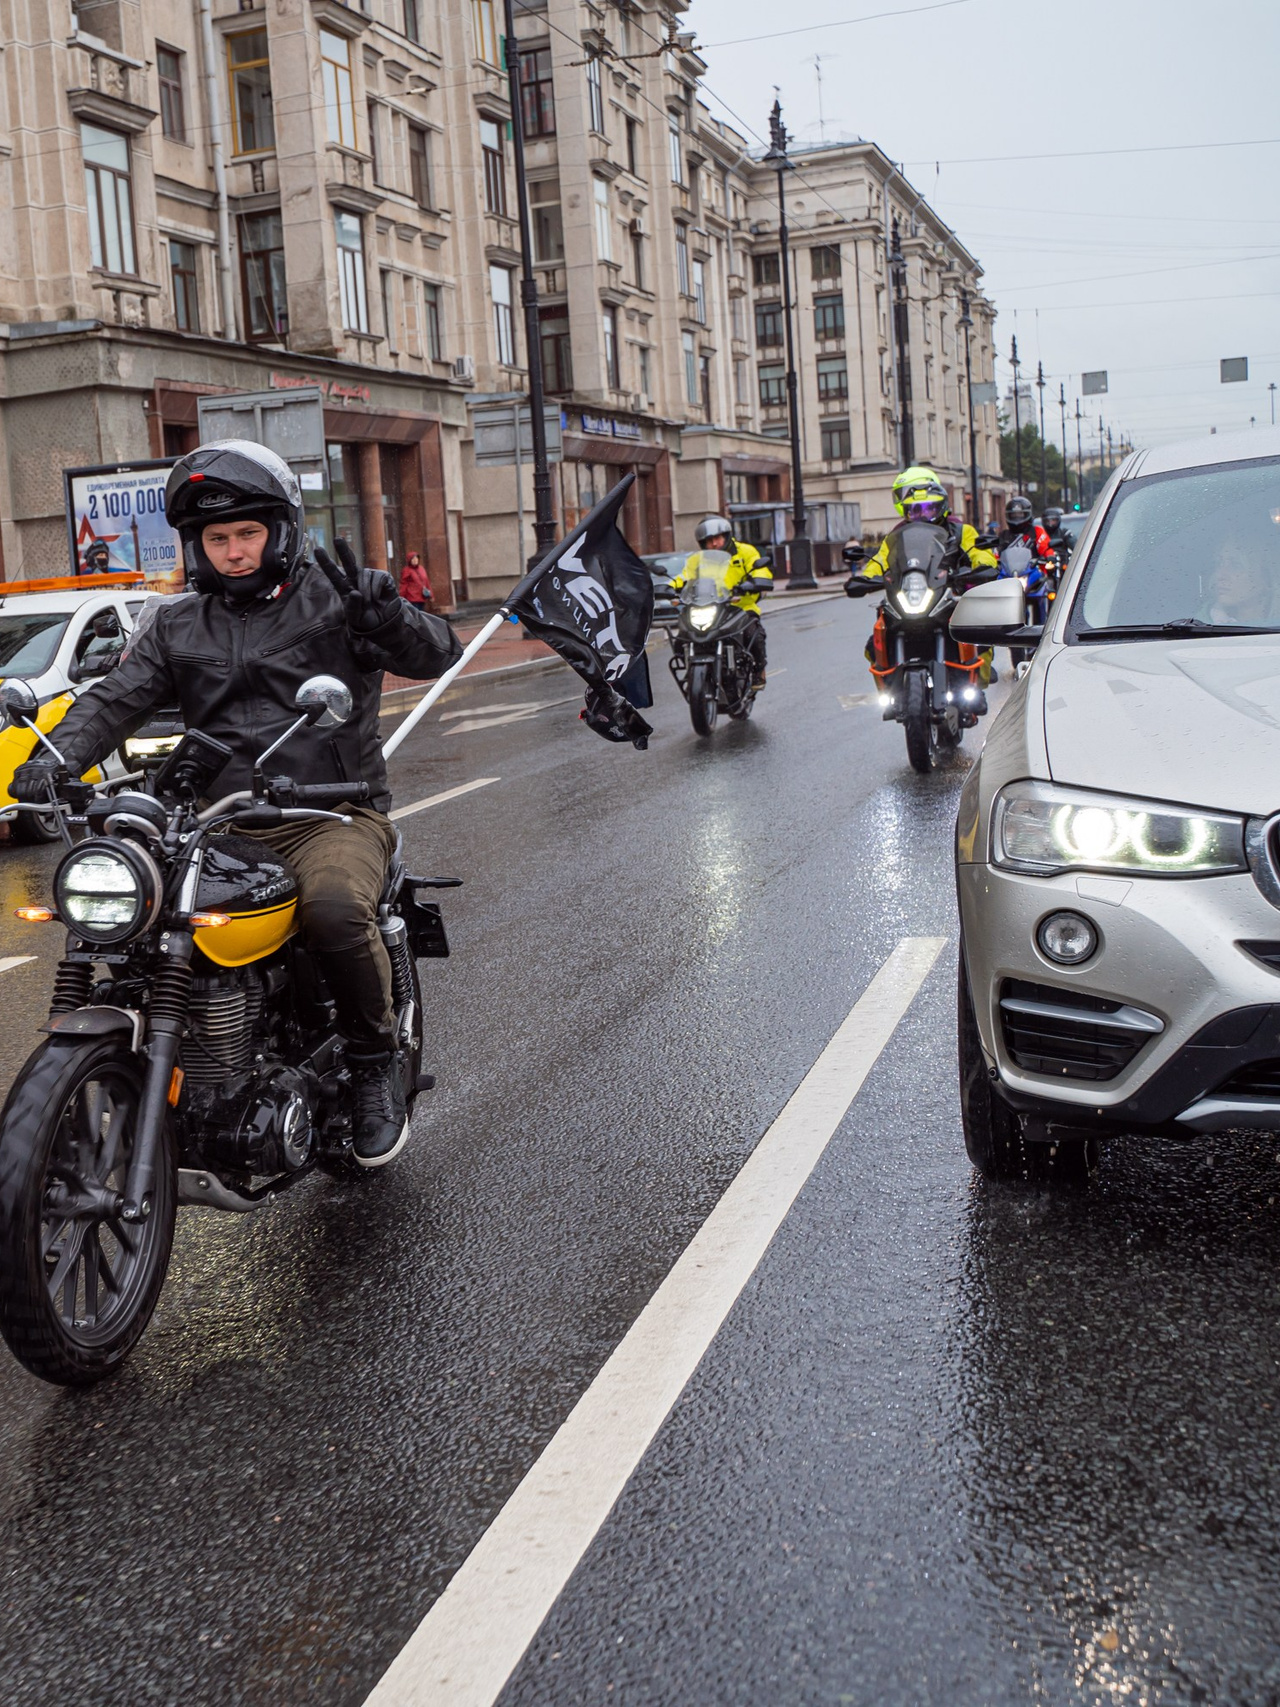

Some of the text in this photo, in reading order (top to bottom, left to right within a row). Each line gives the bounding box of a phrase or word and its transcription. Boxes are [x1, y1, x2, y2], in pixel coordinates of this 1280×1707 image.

[88, 487, 166, 519] 2 100 000
[143, 545, 176, 562] 210 000
